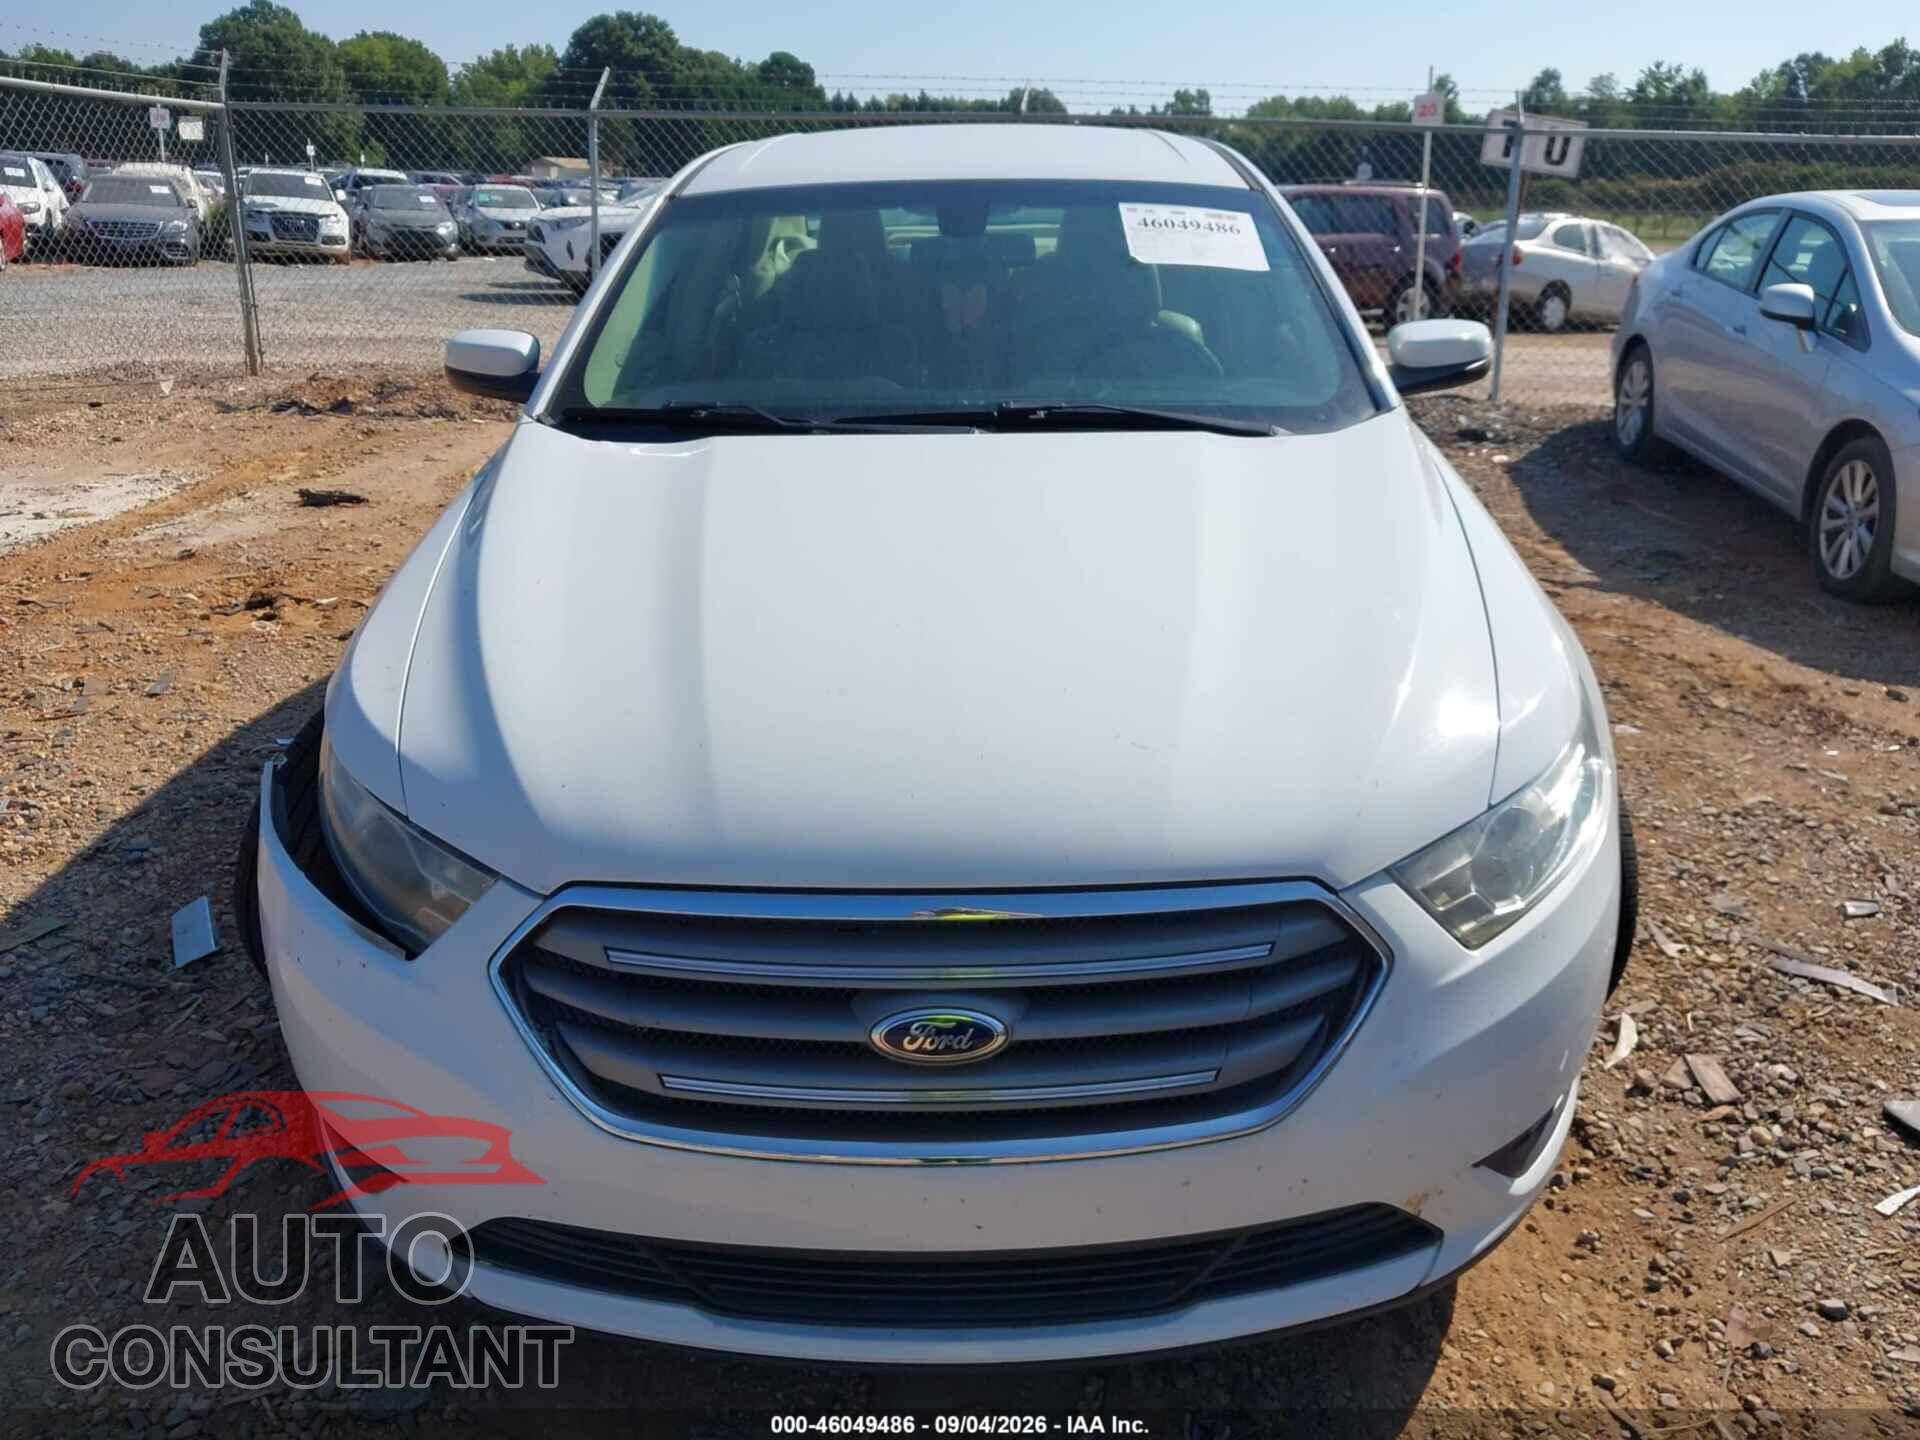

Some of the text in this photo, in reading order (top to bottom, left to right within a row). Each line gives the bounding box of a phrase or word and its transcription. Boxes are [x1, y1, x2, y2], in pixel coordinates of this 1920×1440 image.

[1544, 127, 1572, 166] U
[1137, 217, 1241, 235] 46049486
[902, 1021, 975, 1050] Ford
